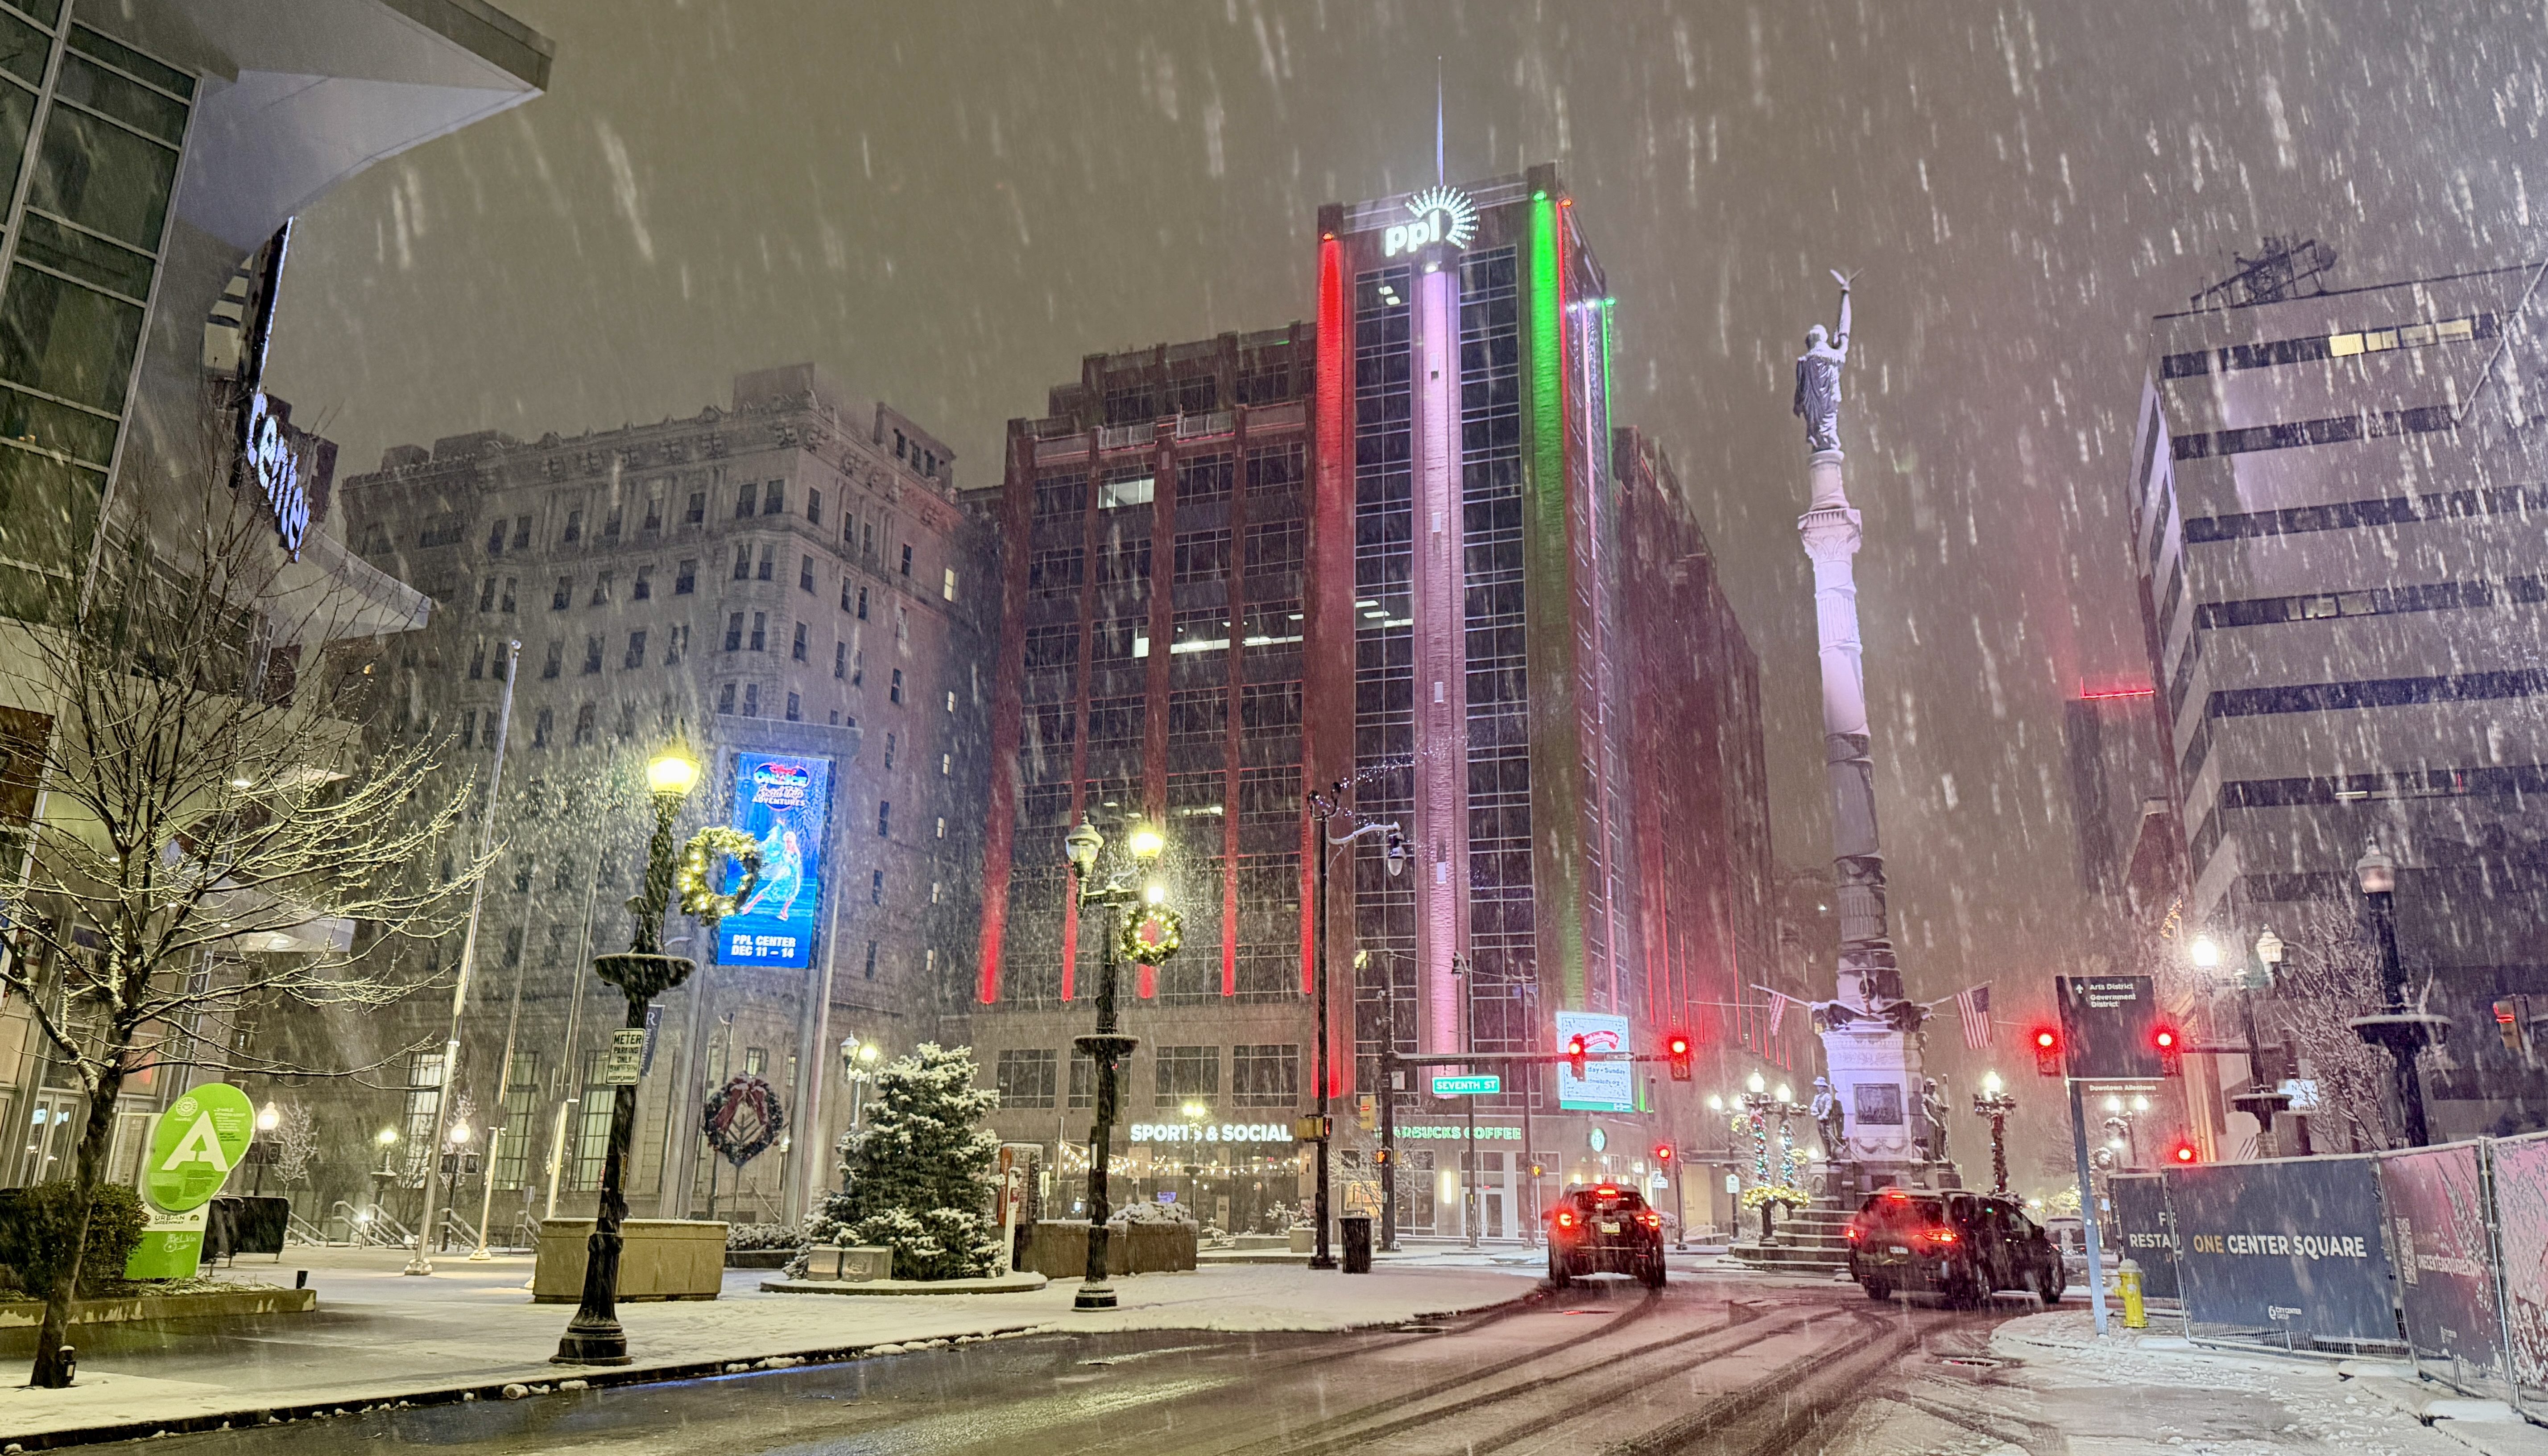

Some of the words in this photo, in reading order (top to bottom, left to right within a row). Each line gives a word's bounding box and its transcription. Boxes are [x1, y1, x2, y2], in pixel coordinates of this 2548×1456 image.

[1385, 209, 1440, 257] ppl
[752, 796, 806, 806] ADVENTURES
[732, 934, 753, 945] PPL
[755, 935, 796, 948] CENTER
[731, 945, 753, 956] DEC
[755, 946, 767, 957] 11
[782, 947, 794, 958] 14
[613, 1035, 642, 1044] METER
[1436, 1081, 1481, 1090] SEVENTH
[1484, 1081, 1497, 1089] ST
[1130, 1124, 1203, 1142] SPORTS
[1205, 1126, 1219, 1142] &
[1221, 1124, 1293, 1142] SOCIAL
[161, 1110, 228, 1171] A
[2193, 1235, 2224, 1254] ONE
[2228, 1235, 2290, 1255] CENTER
[2293, 1235, 2367, 1260] SQUARE
